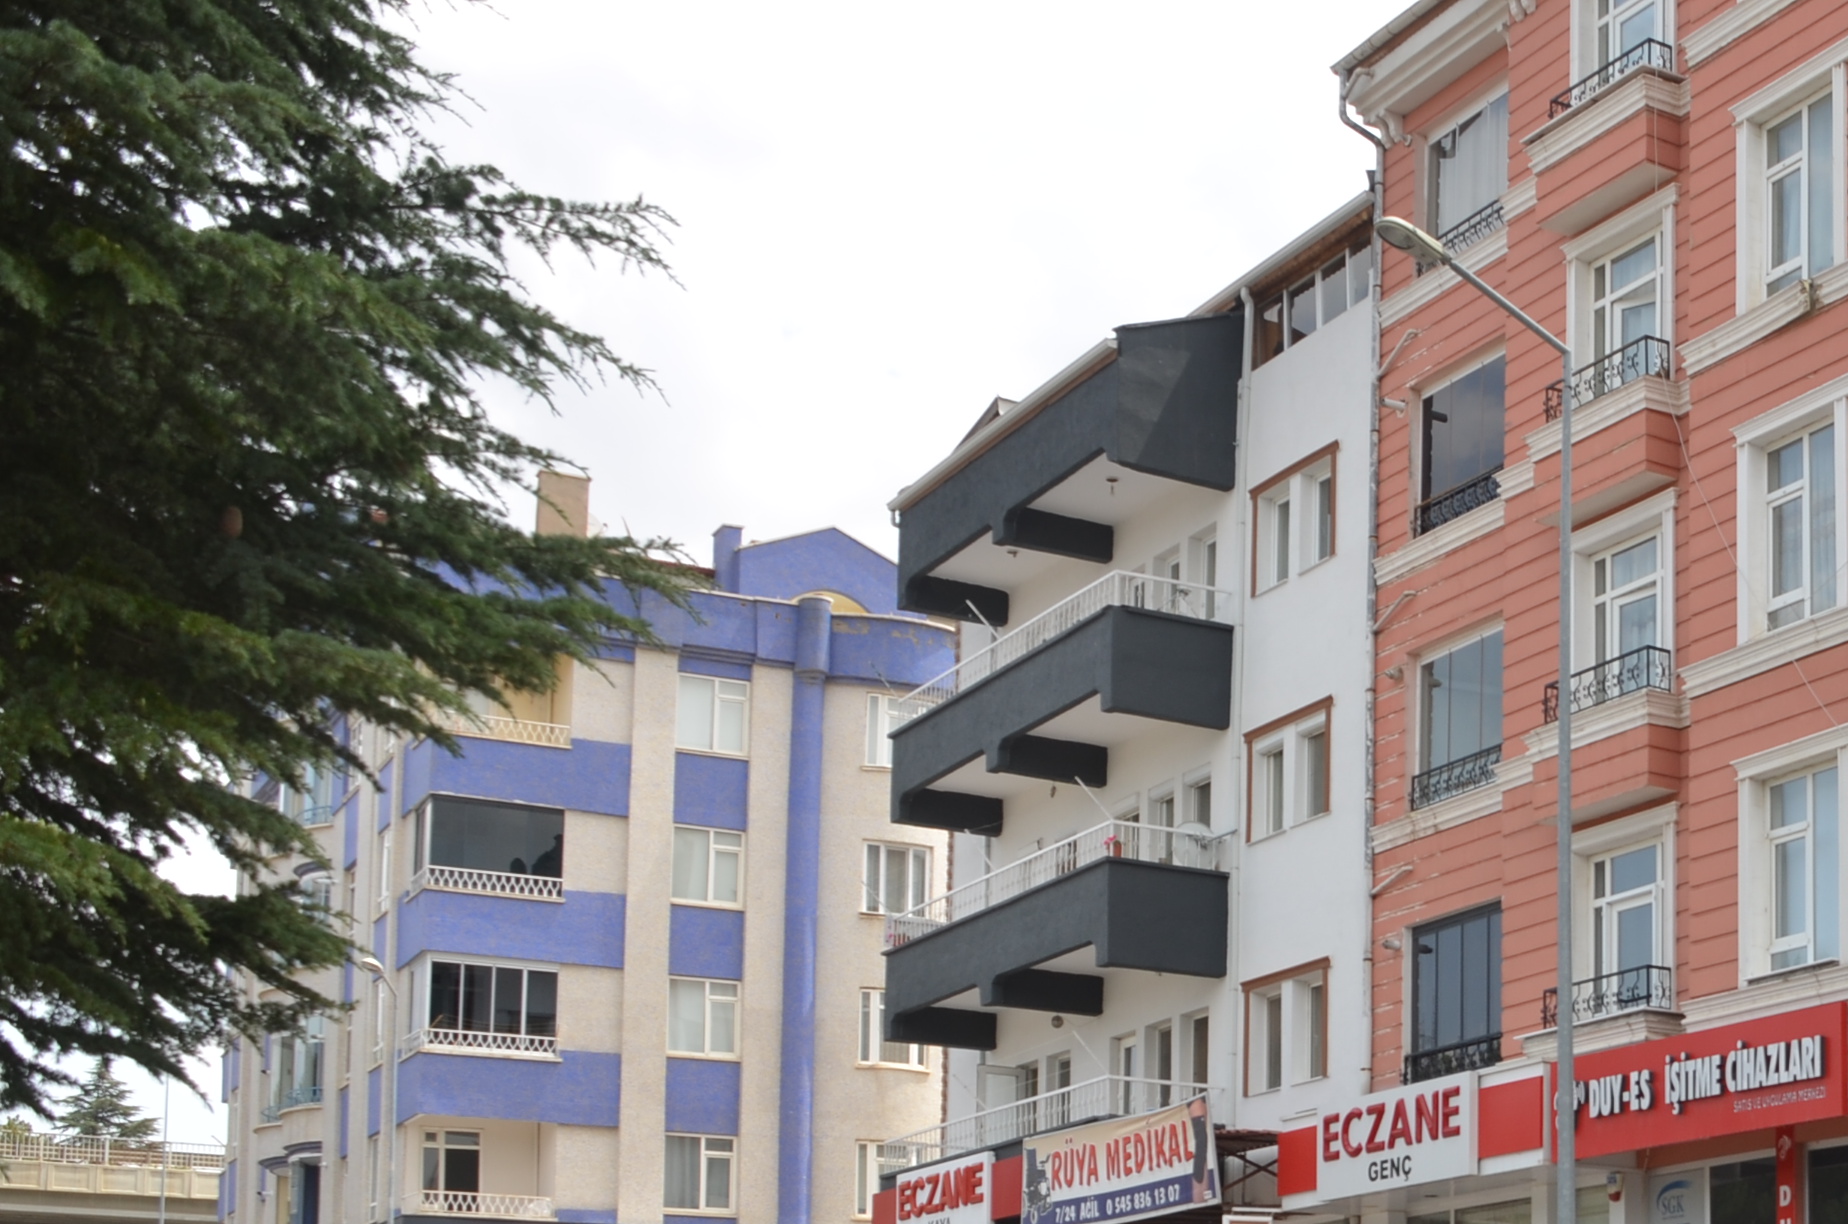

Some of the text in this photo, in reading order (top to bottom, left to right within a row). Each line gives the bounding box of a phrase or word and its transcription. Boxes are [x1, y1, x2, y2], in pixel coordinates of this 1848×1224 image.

[1588, 1034, 1824, 1120] DUY-ES İŞİTME CİHAZLARI
[1051, 1120, 1196, 1192] RÜYA MEDİKAL
[1322, 1085, 1461, 1163] ECZANE
[898, 1161, 984, 1221] ECZANE
[1367, 1154, 1413, 1182] GENÇ
[1054, 1205, 1076, 1224] 7/24
[1106, 1198, 1113, 1216] 0
[1114, 1194, 1132, 1214] 545
[1133, 1191, 1152, 1211] 836
[1154, 1187, 1165, 1205] 13
[1167, 1183, 1181, 1202] 07
